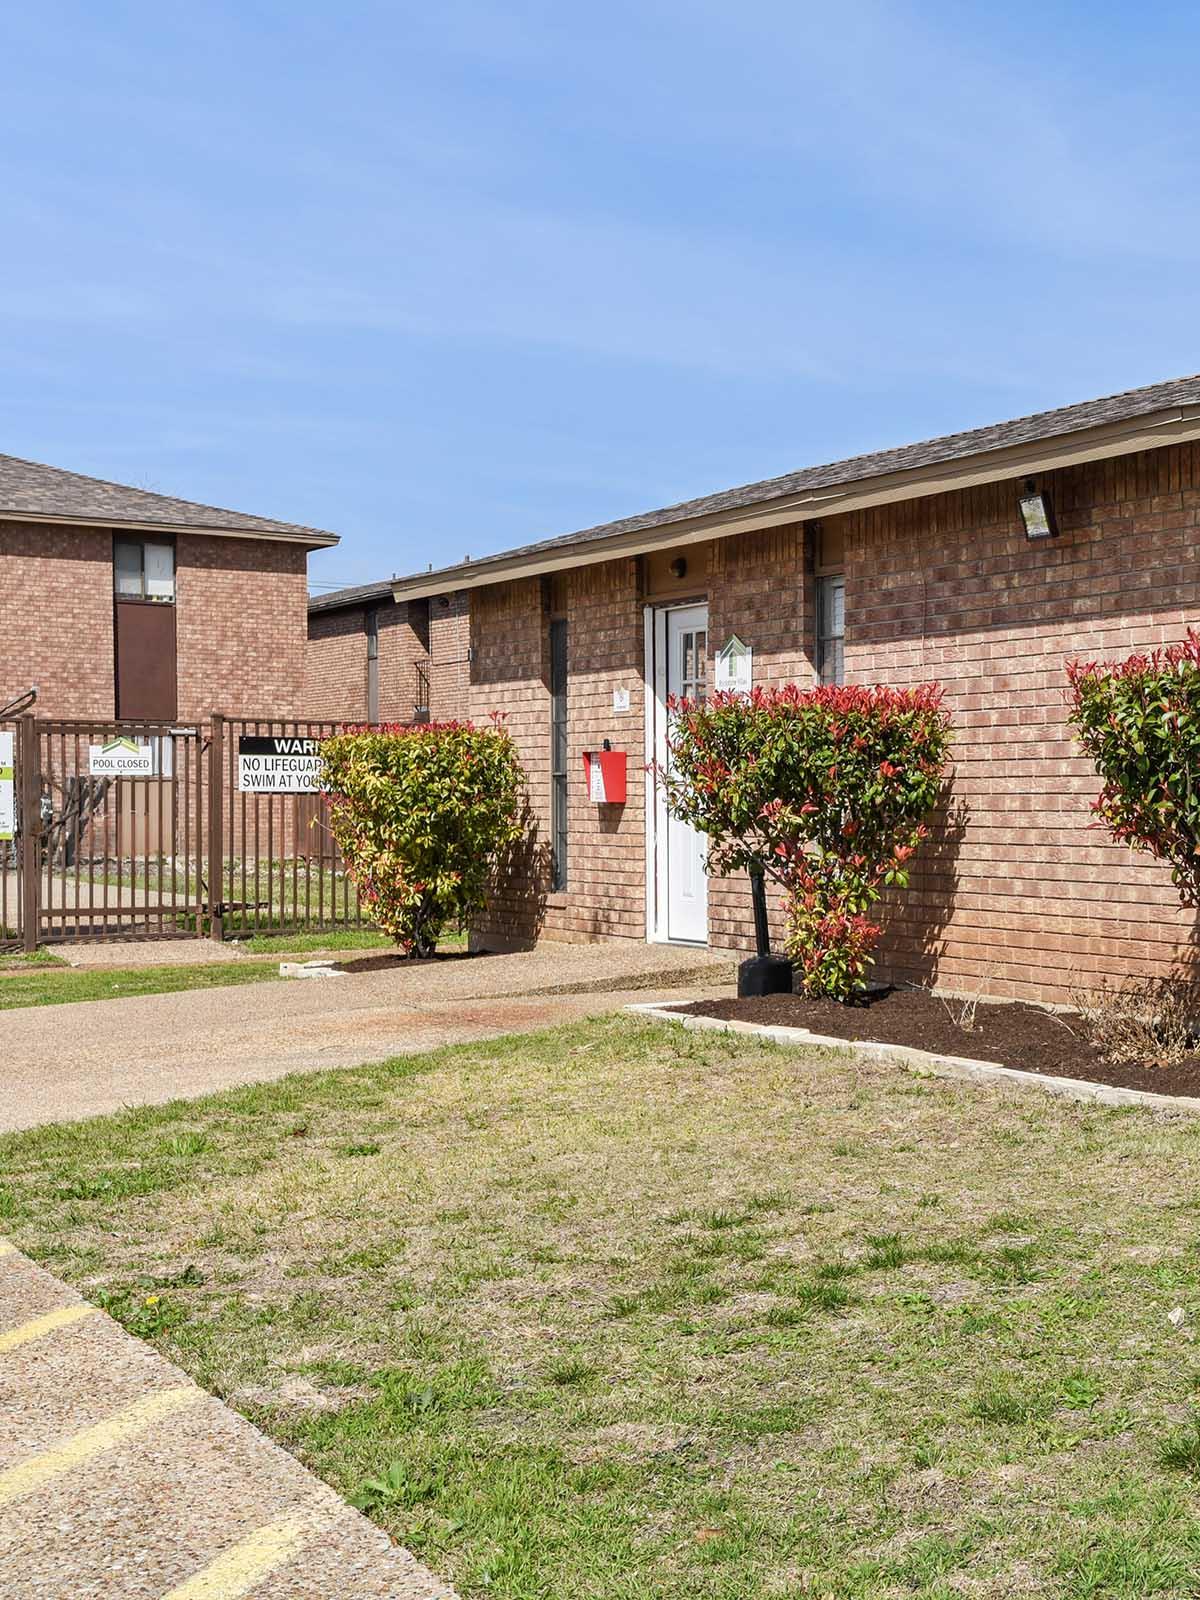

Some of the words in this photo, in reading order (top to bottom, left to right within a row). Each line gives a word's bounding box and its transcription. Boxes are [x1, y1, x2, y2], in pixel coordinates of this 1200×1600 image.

[93, 759, 115, 769] POOL
[117, 759, 150, 769] CLOSED
[242, 758, 261, 772] NO
[264, 758, 324, 772] LIFEGUAR
[243, 774, 275, 788] SWIM
[279, 774, 293, 788] AT
